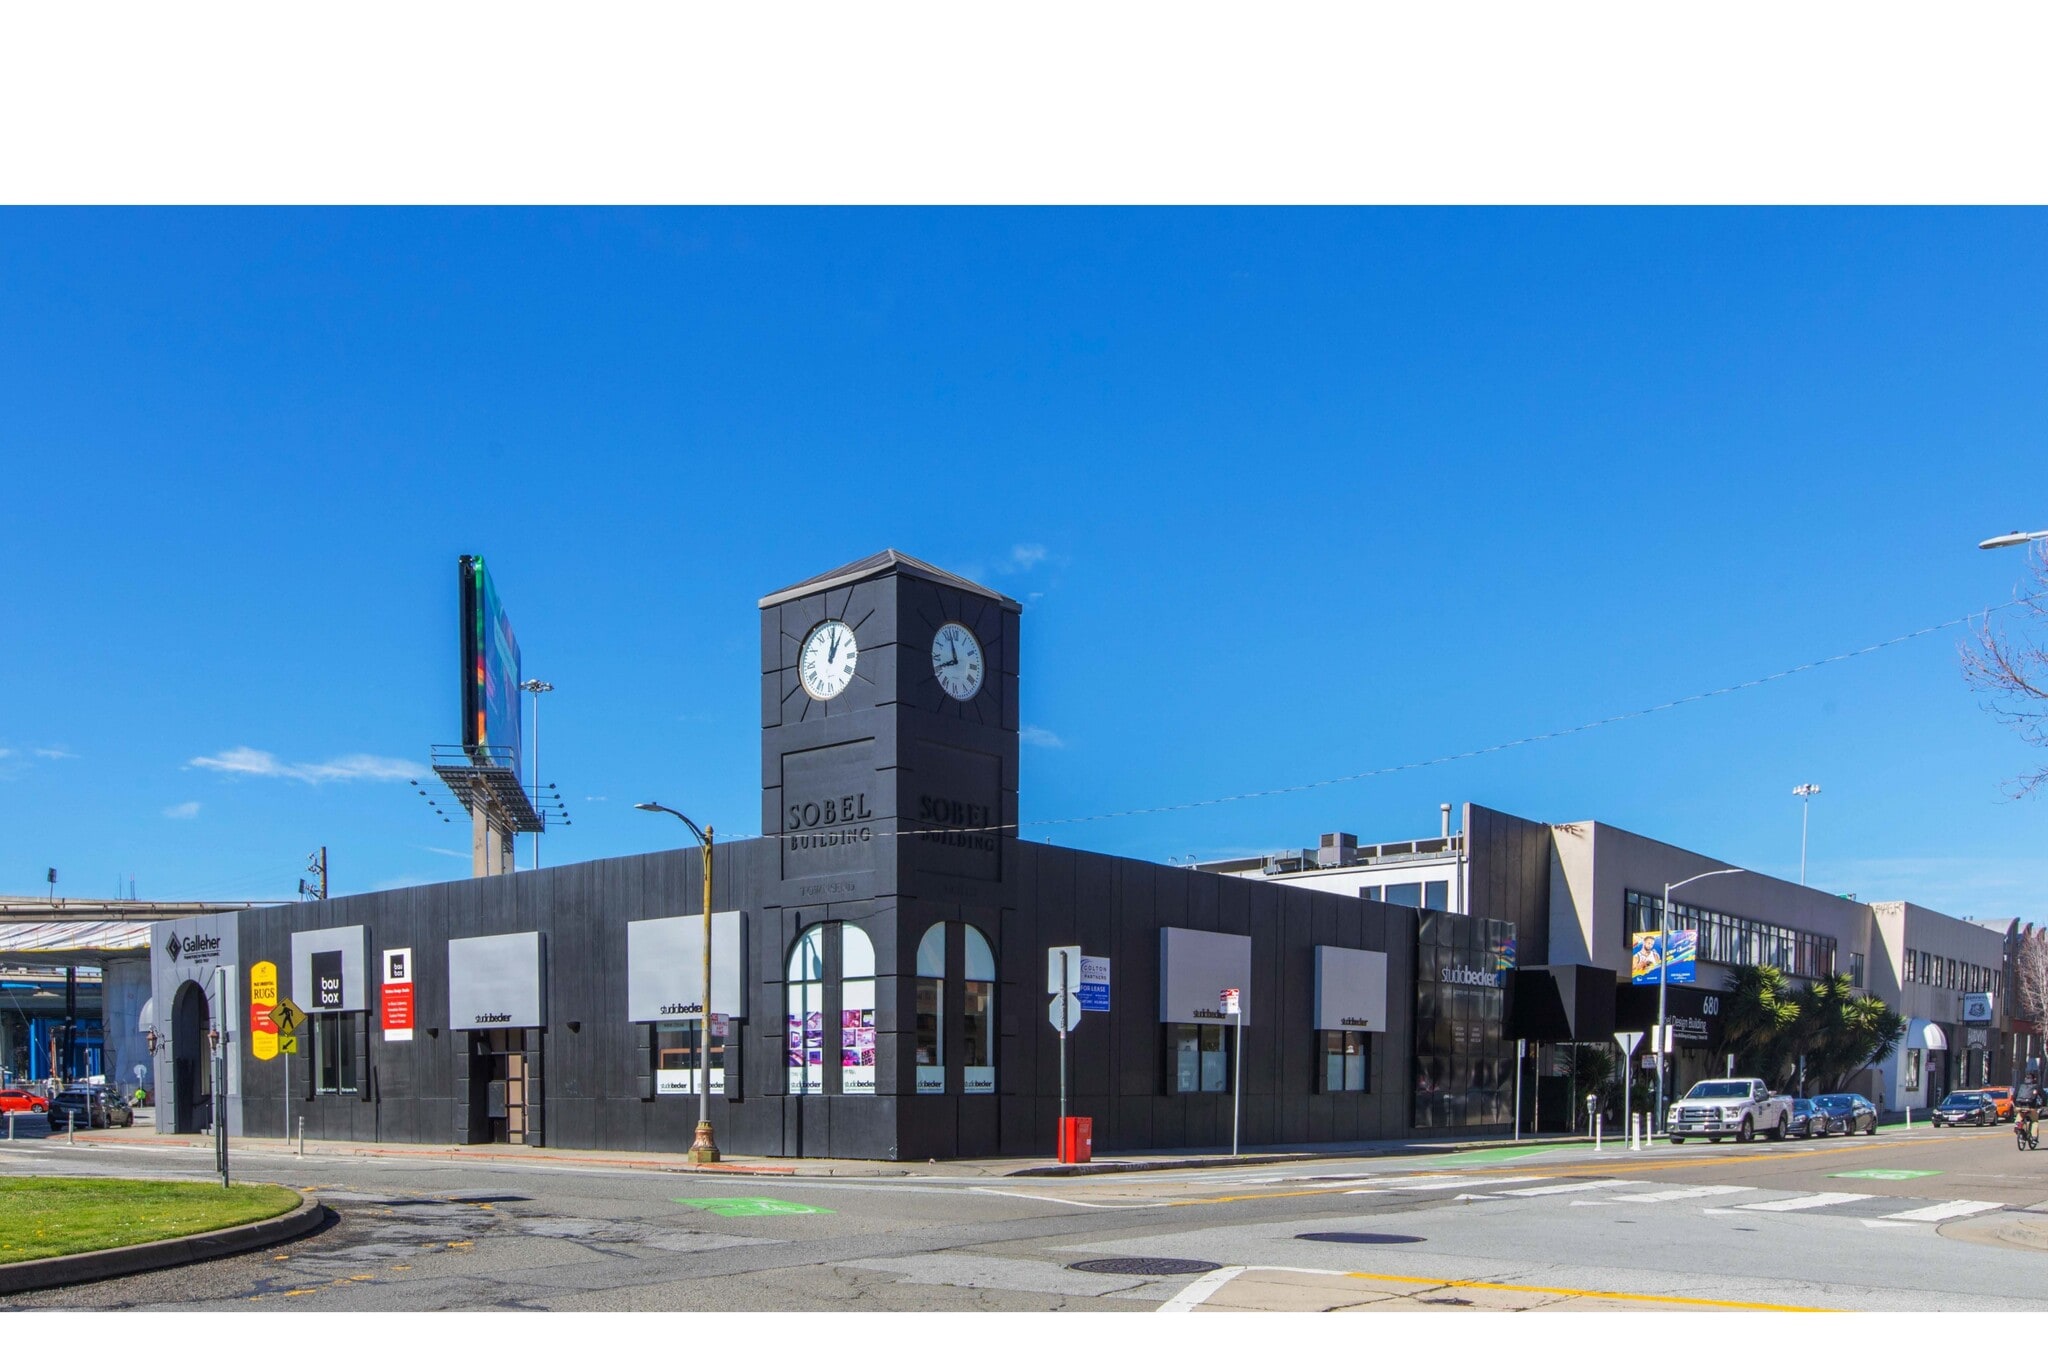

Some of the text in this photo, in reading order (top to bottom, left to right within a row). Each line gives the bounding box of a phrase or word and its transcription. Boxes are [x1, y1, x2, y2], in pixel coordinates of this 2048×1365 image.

[789, 793, 872, 830] SOBEL
[919, 794, 991, 827] SOBEL
[791, 827, 871, 851] BUILDING
[919, 828, 994, 852] BUILDING
[183, 934, 221, 952] Galleher
[321, 976, 339, 990] bau
[253, 988, 275, 1000] RUGS
[321, 990, 339, 1004] box
[1703, 996, 1719, 1015] 680
